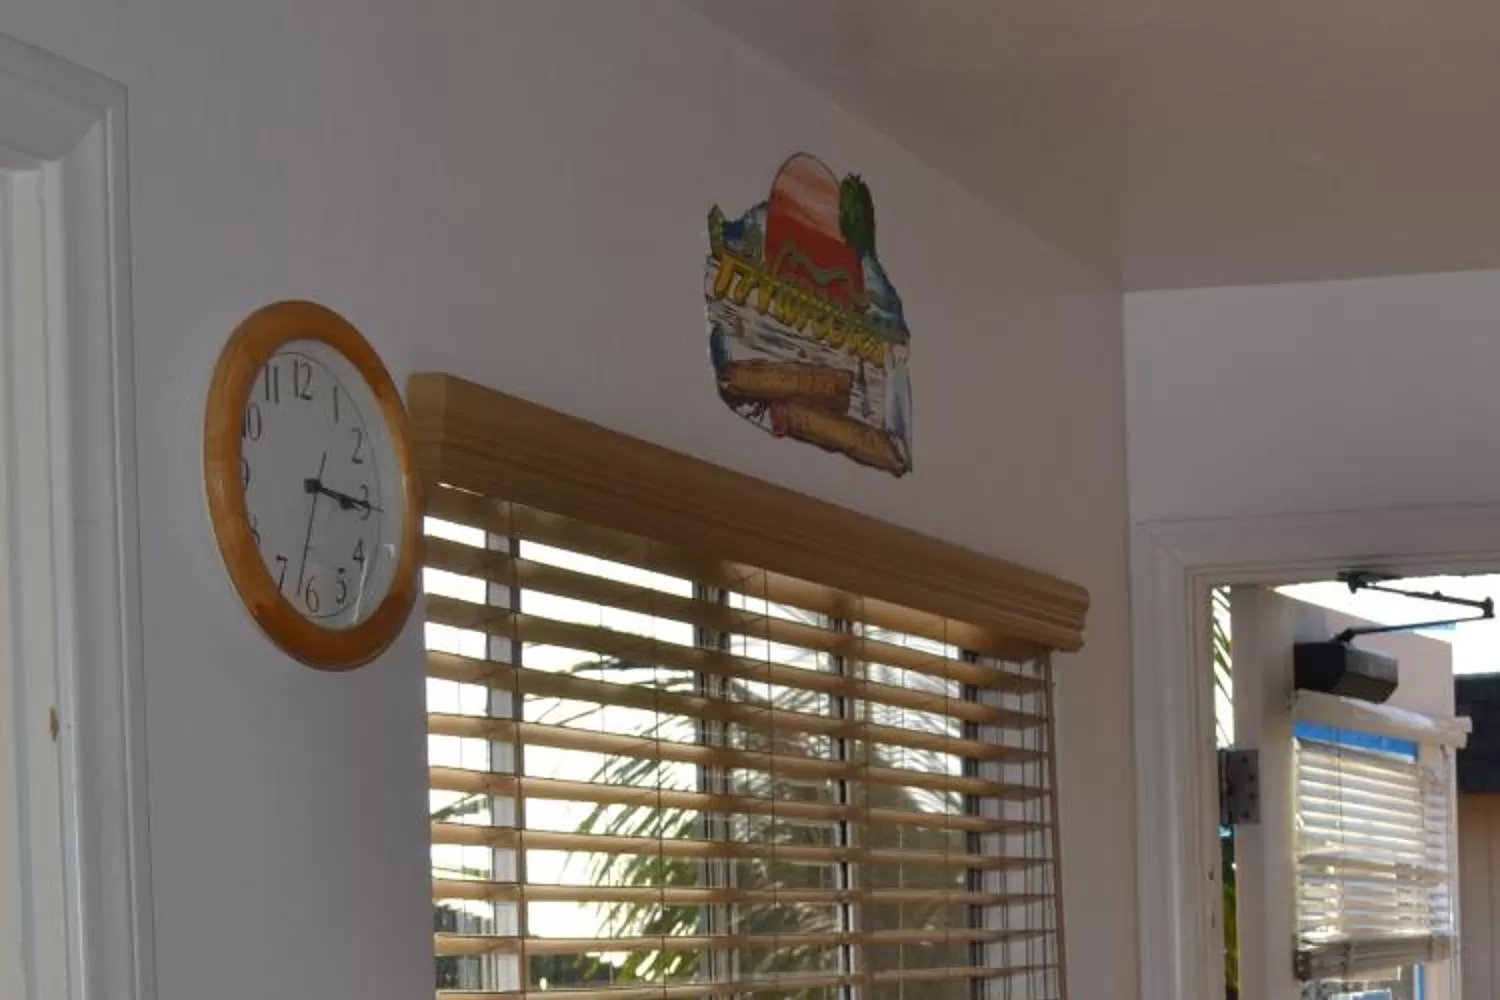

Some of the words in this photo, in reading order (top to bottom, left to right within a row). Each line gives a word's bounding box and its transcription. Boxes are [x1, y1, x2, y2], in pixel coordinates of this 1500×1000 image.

[264, 363, 279, 405] 11
[293, 359, 313, 401] 12
[351, 426, 364, 464] 2
[304, 575, 321, 613] 6
